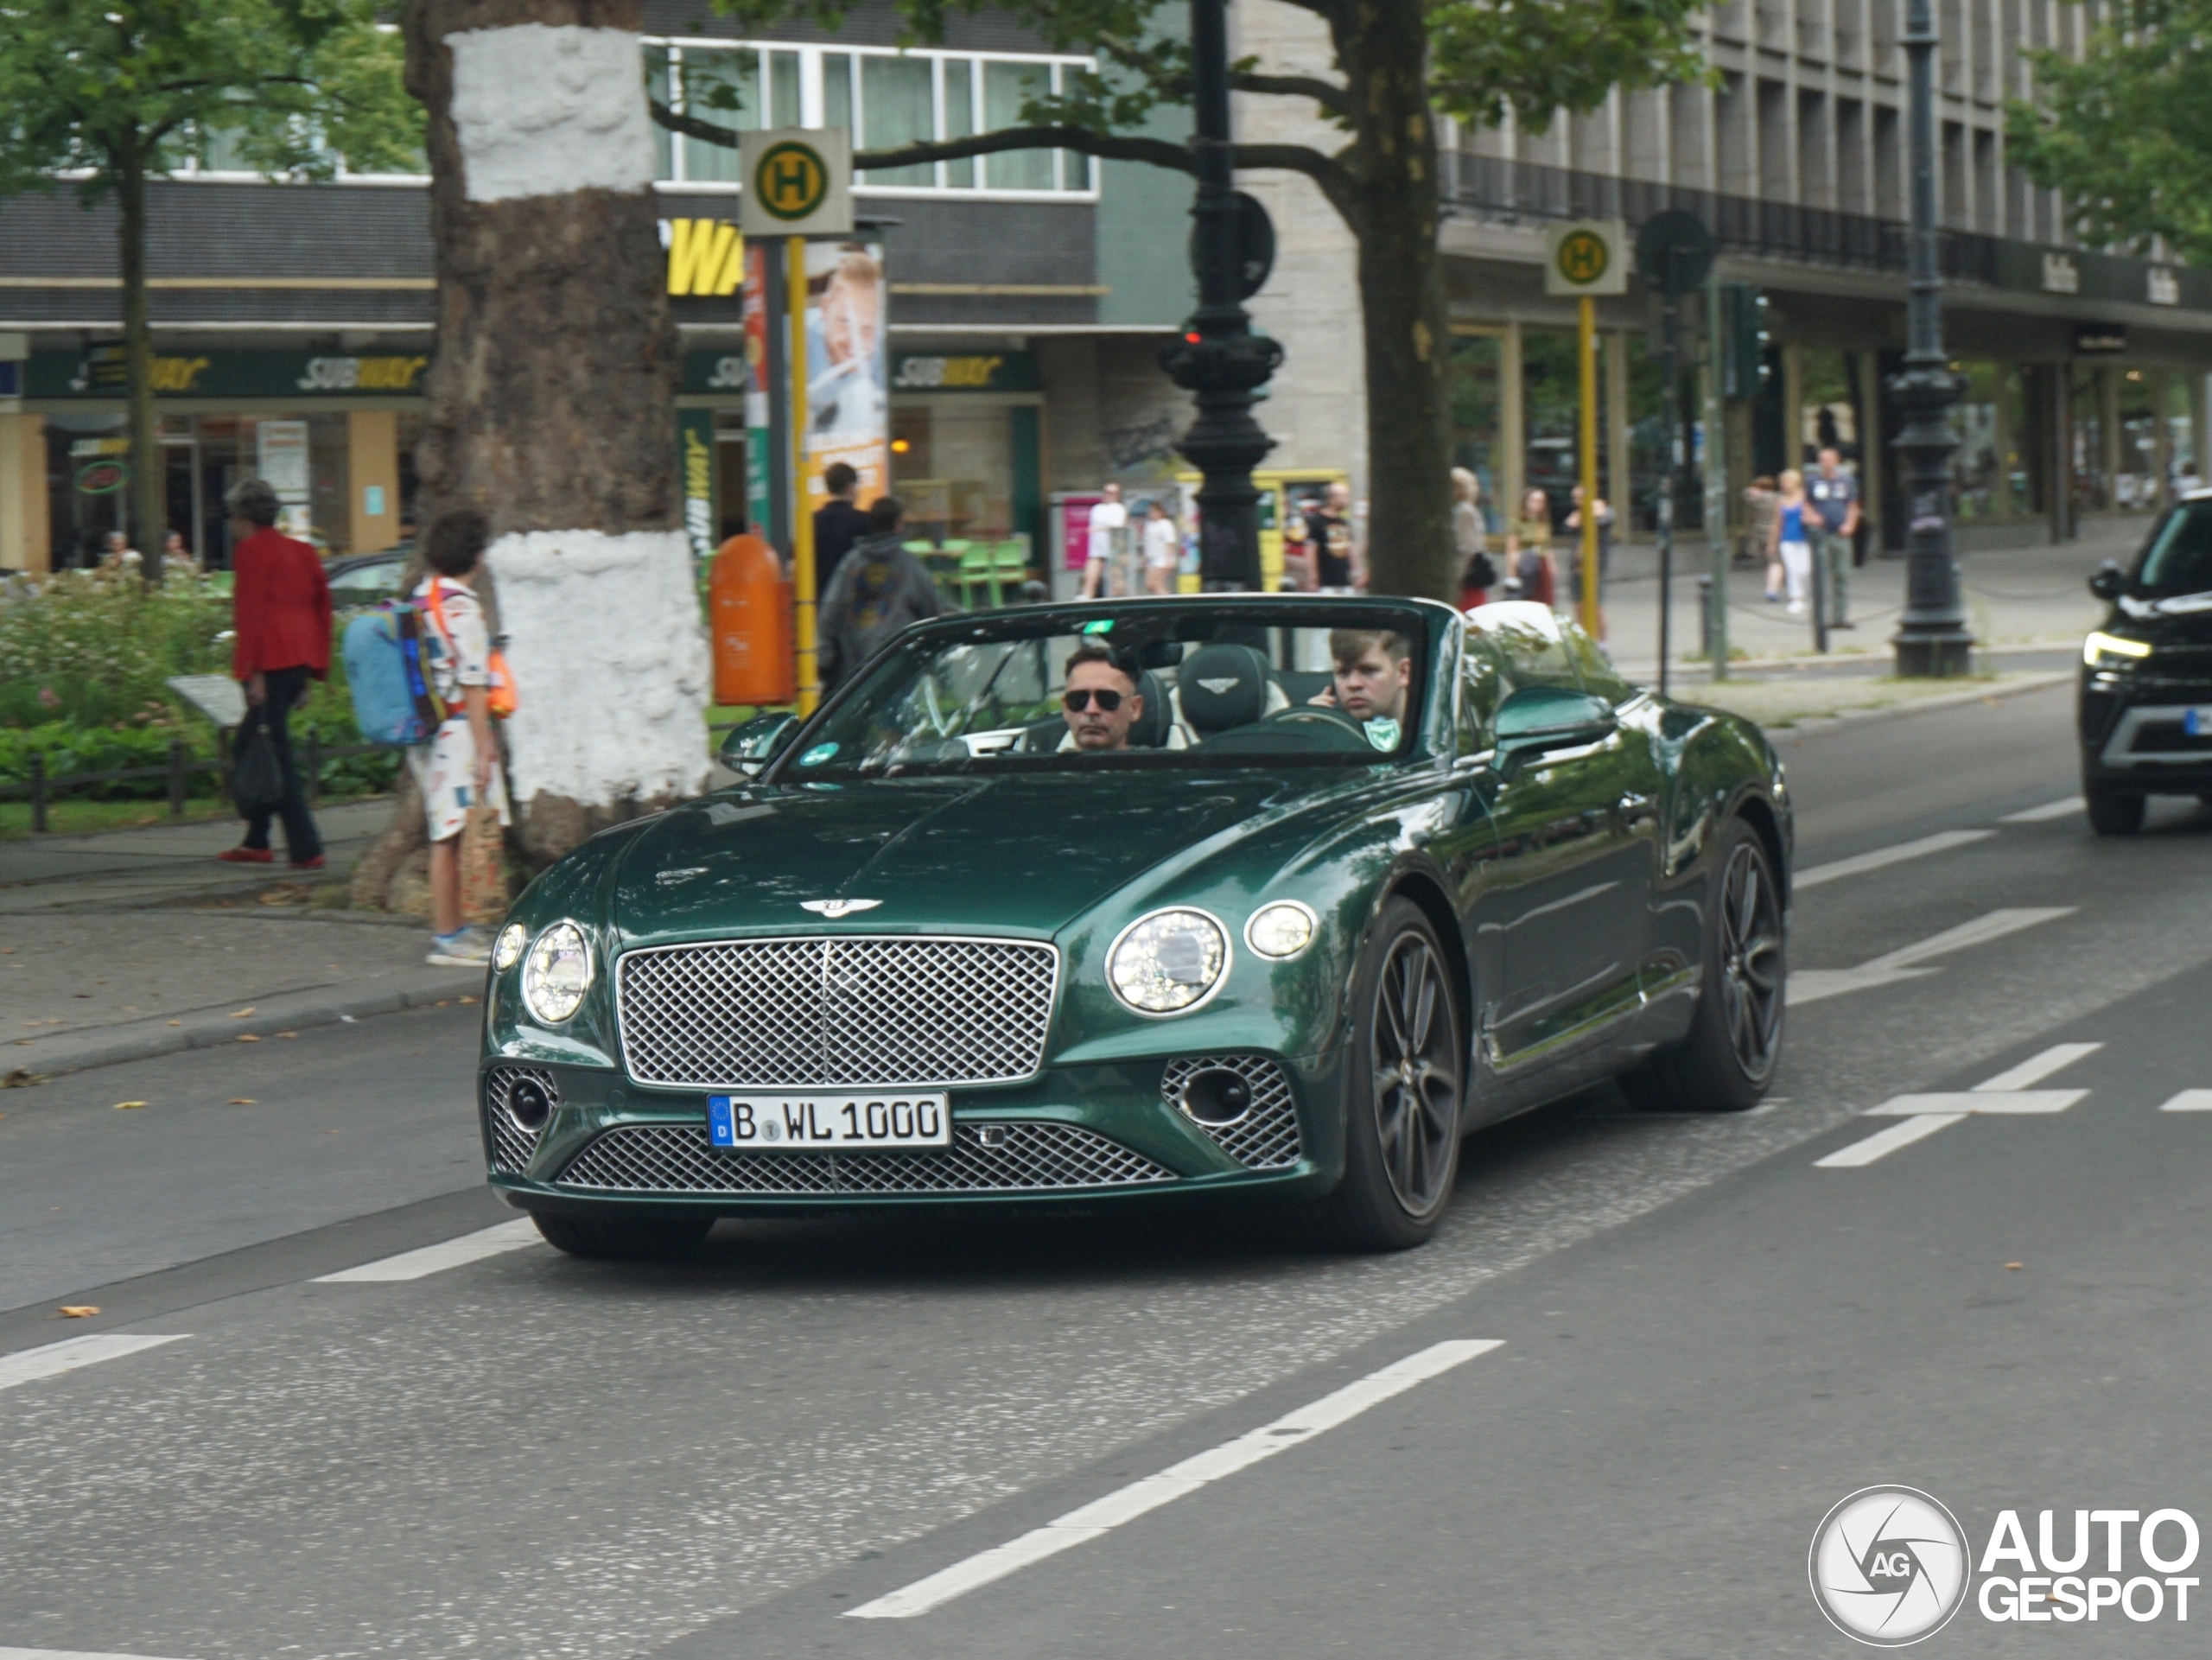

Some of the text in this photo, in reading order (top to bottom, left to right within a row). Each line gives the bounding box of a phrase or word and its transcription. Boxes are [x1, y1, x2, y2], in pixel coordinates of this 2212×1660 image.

[773, 159, 807, 202] H
[1571, 241, 1596, 274] H
[296, 356, 428, 390] SUBWAY
[894, 355, 1004, 387] SUBWAY
[717, 1125, 727, 1138] D
[733, 1103, 756, 1140] B
